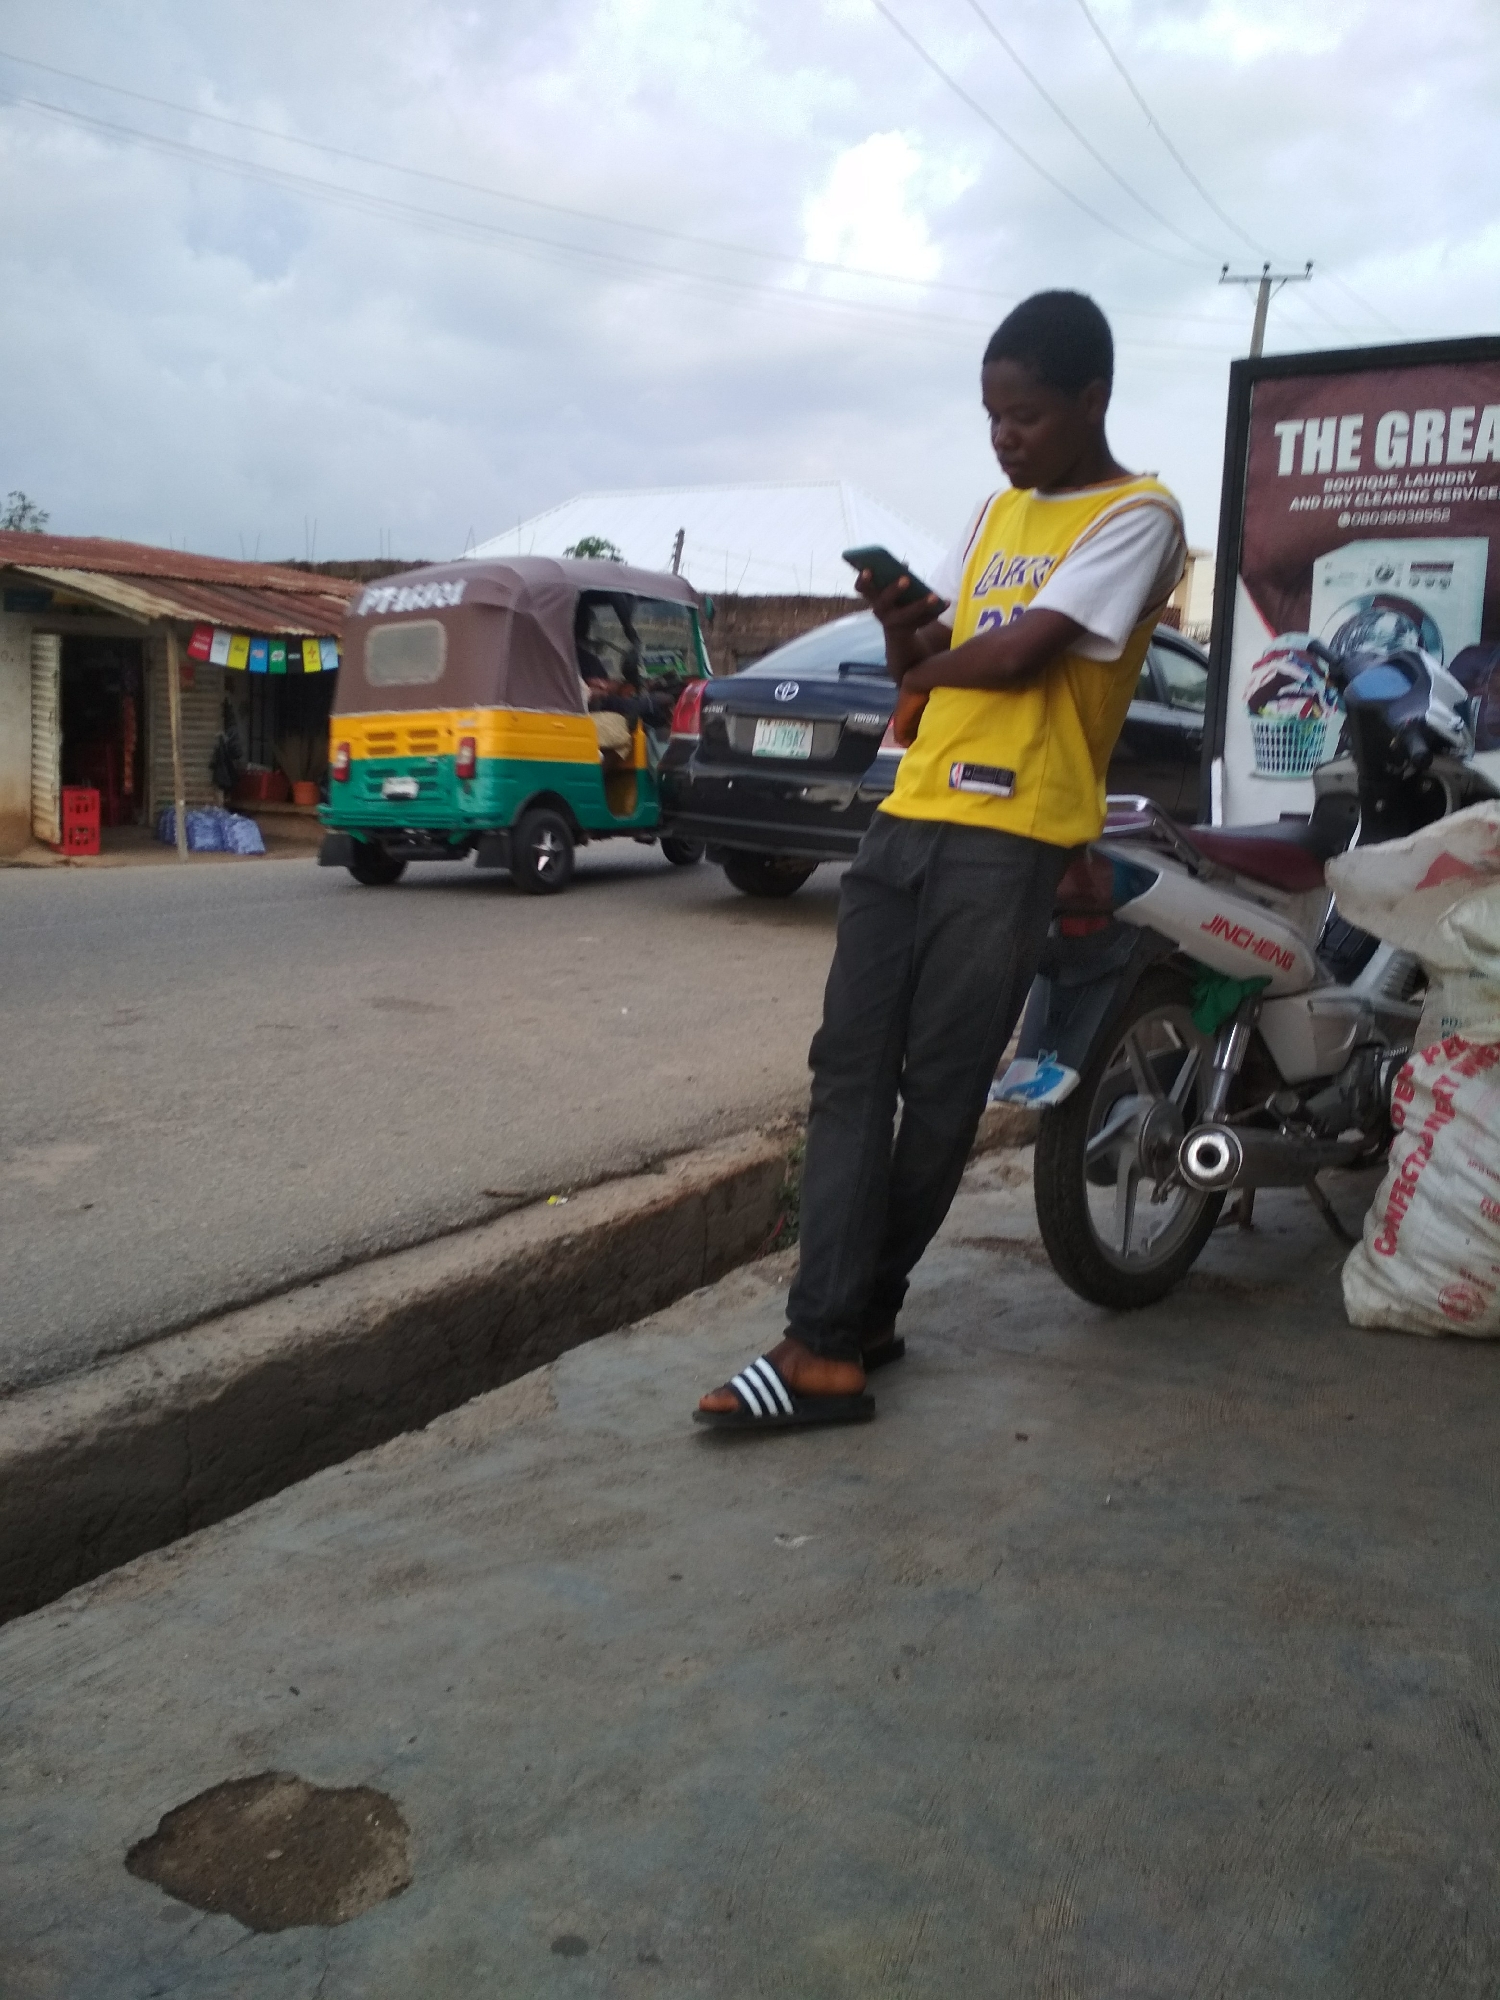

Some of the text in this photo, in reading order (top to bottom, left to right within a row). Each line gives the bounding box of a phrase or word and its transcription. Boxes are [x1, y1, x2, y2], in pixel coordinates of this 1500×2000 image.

[1274, 404, 1500, 476] THE GREA
[1289, 485, 1500, 512] AND DRY CLEANING SERVICE
[1404, 470, 1477, 488] LAUNDRY
[1200, 912, 1296, 973] JINCHENG
